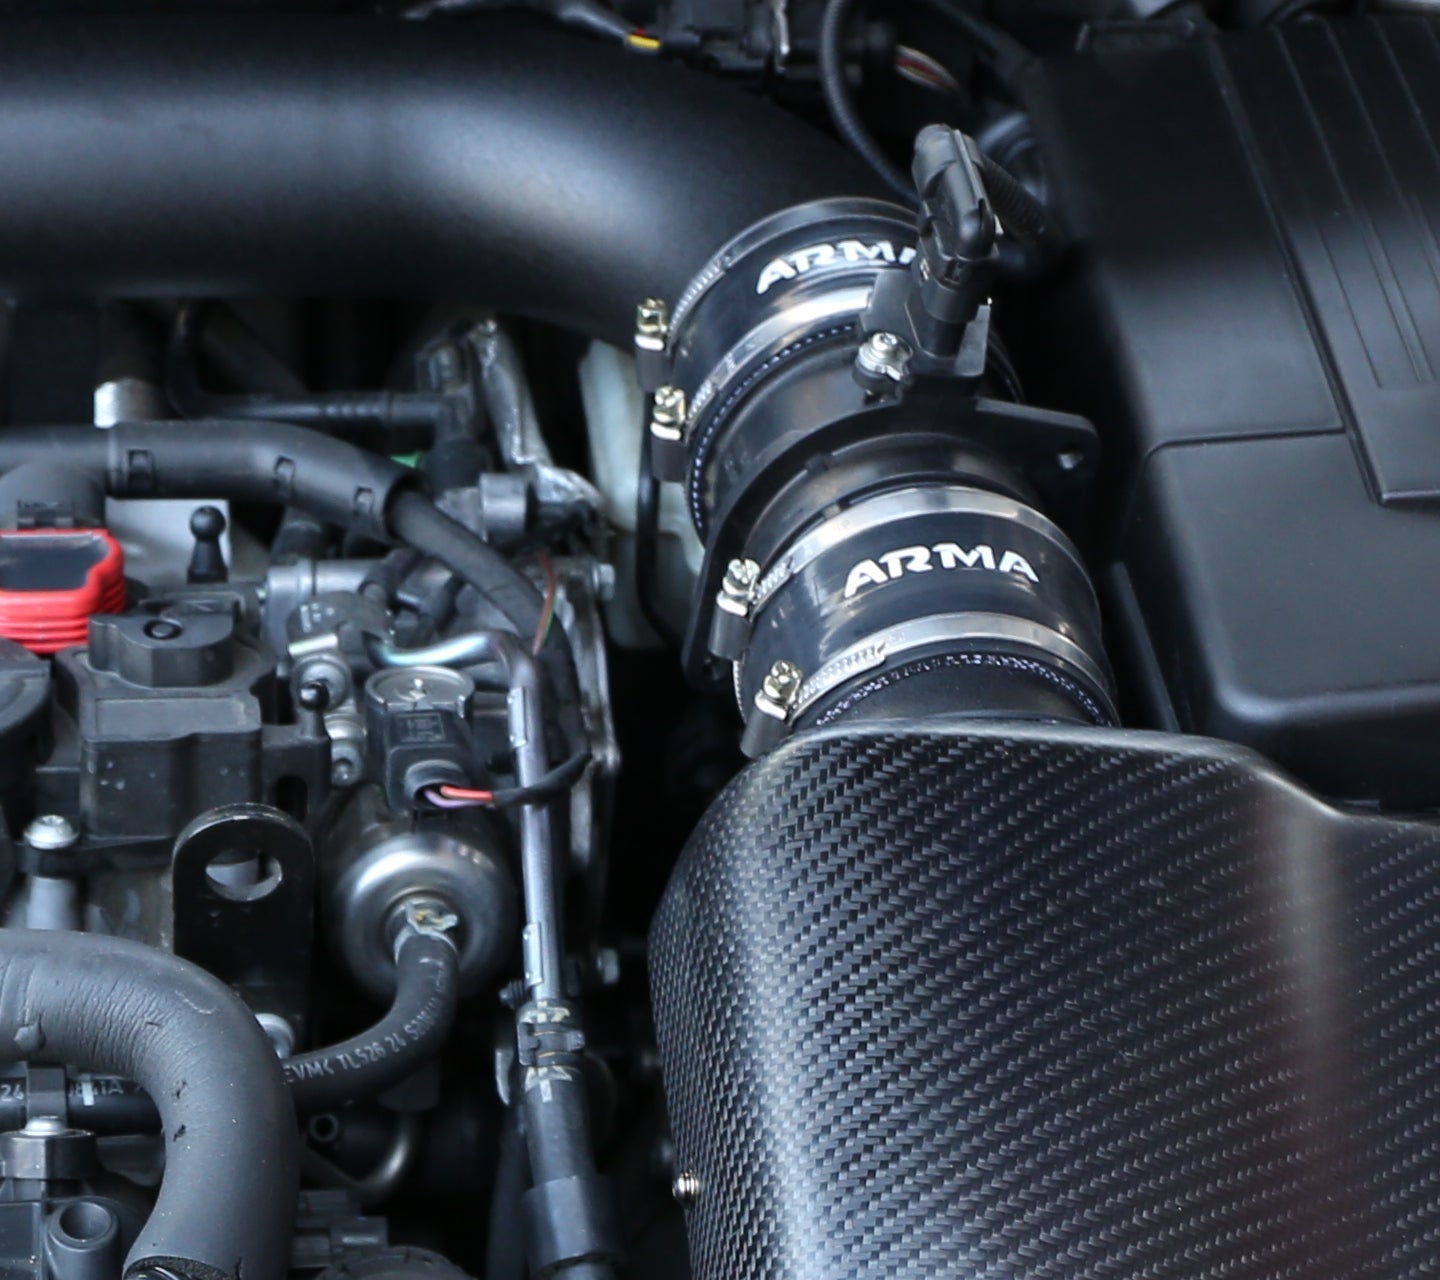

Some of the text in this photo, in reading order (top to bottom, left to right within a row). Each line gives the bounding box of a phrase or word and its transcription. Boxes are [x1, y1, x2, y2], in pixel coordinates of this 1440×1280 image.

[756, 240, 917, 295] ARM
[843, 542, 1040, 598] ARMA
[0, 1085, 24, 1102] 24
